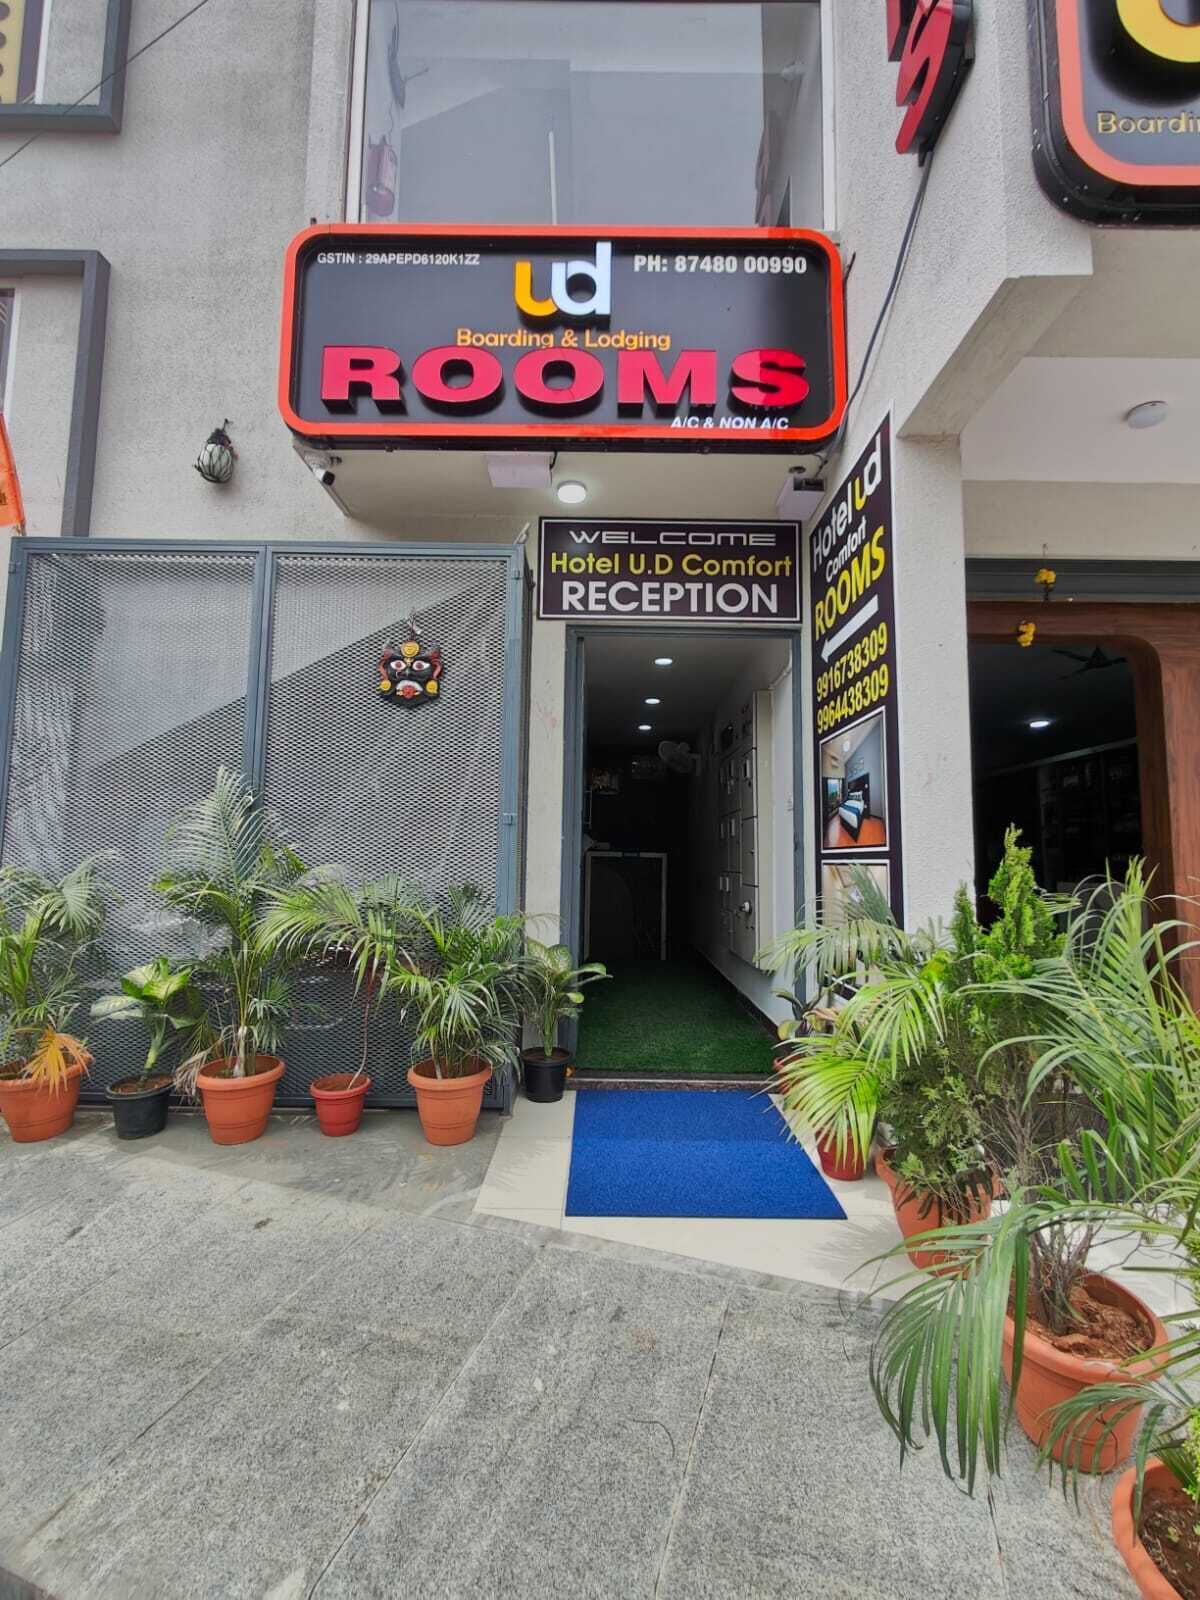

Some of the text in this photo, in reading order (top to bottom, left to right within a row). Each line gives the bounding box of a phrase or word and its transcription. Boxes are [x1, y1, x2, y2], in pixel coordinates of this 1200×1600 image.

[1097, 111, 1200, 134] Boardi
[317, 252, 355, 264] GSTIN
[633, 254, 808, 274] PH: 87480 00990
[456, 328, 671, 350] Boarding & Lodging
[321, 345, 810, 407] ROOMS
[670, 416, 789, 430] A/C & NON A/C
[569, 530, 777, 546] WELCOME
[813, 481, 853, 573] Hotel
[551, 552, 792, 577] Hotel U.D Comfort
[815, 525, 885, 641] ROOMS
[562, 581, 778, 613] RECEPTION
[816, 622, 888, 702] 9916738309
[817, 663, 889, 734] 9964438309
